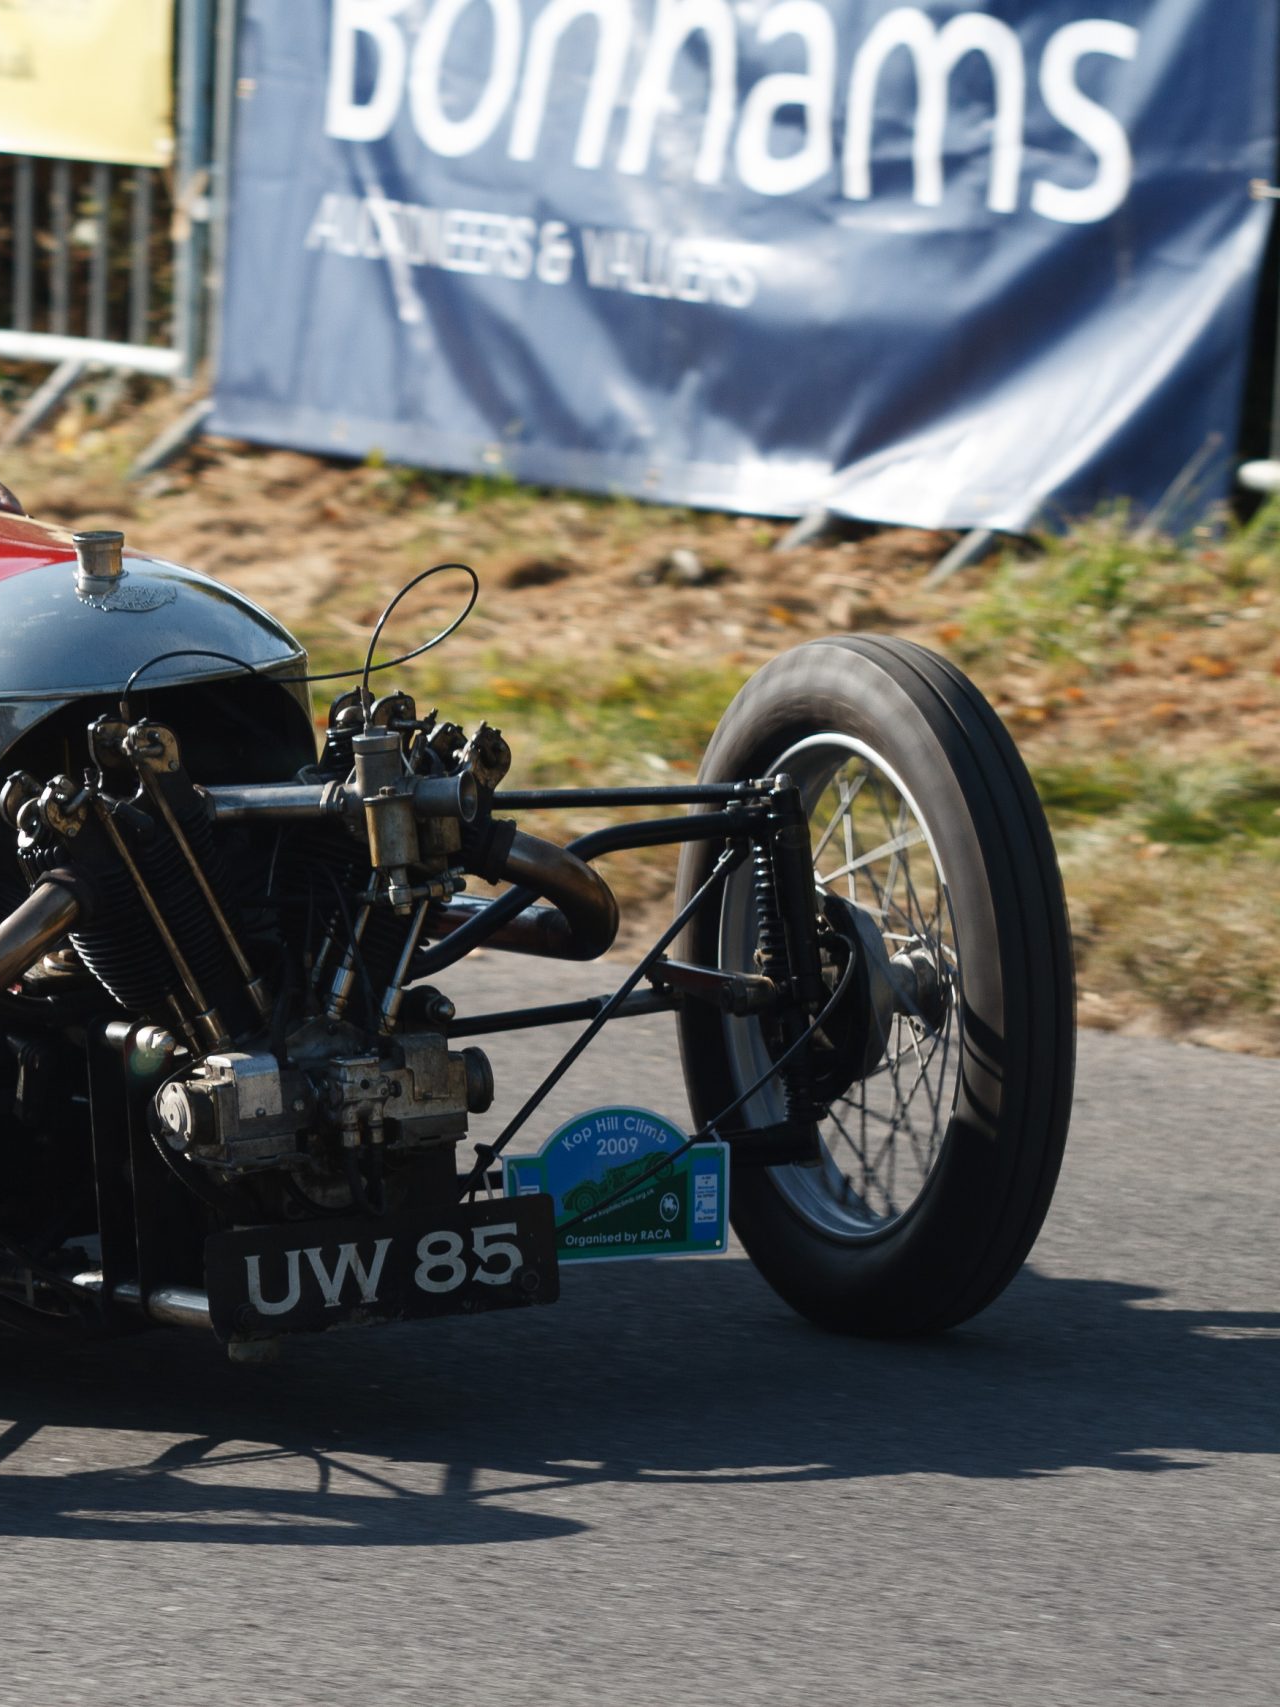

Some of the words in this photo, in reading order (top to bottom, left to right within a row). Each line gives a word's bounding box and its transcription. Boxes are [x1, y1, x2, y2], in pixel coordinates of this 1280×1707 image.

[561, 1127, 592, 1151] Kop
[595, 1116, 619, 1134] Hill
[624, 1117, 667, 1144] Climb
[596, 1137, 639, 1156] 2009
[565, 1232, 622, 1248] Organised
[624, 1231, 638, 1244] by
[640, 1228, 672, 1241] RACA
[244, 1238, 394, 1316] UW
[414, 1222, 524, 1294] 85
